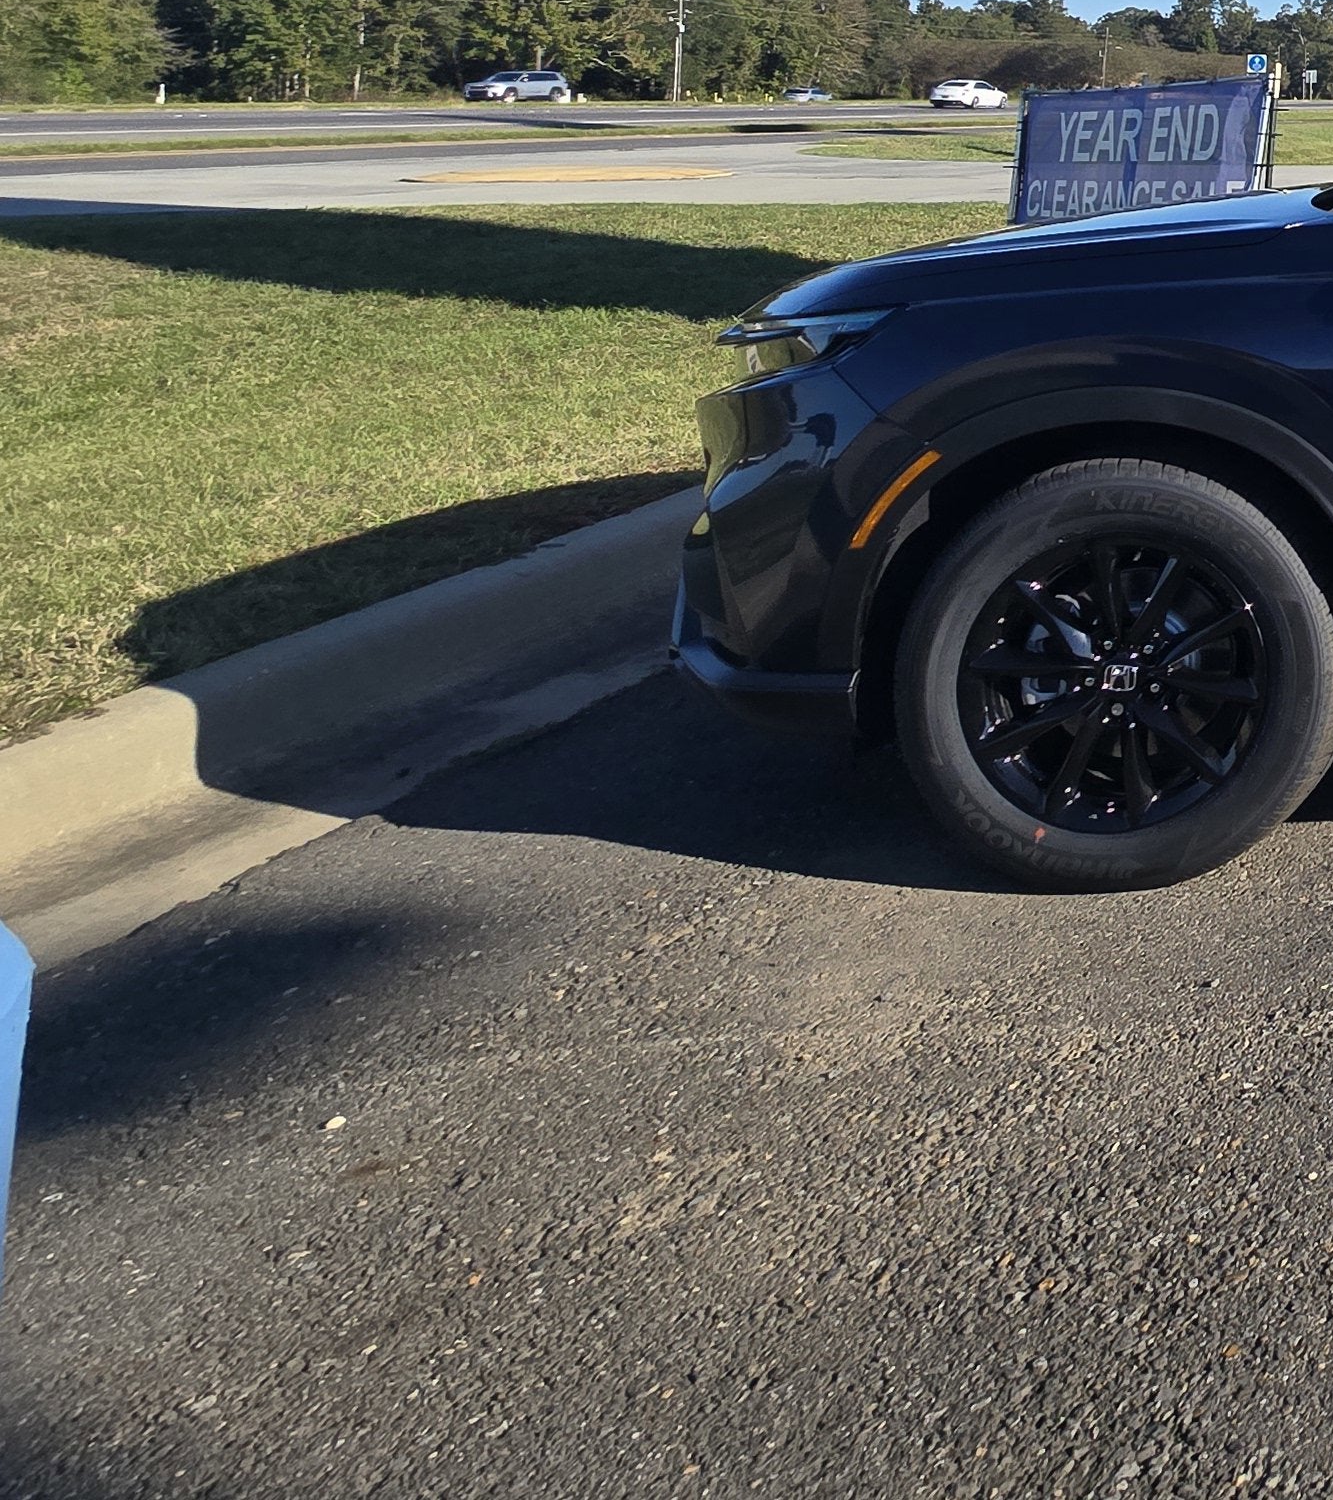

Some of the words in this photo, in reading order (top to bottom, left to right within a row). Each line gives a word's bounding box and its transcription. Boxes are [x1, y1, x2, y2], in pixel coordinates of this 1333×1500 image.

[1058, 108, 1144, 163] YEAR
[1147, 103, 1220, 162] END
[1026, 179, 1167, 218] CLEARANCE
